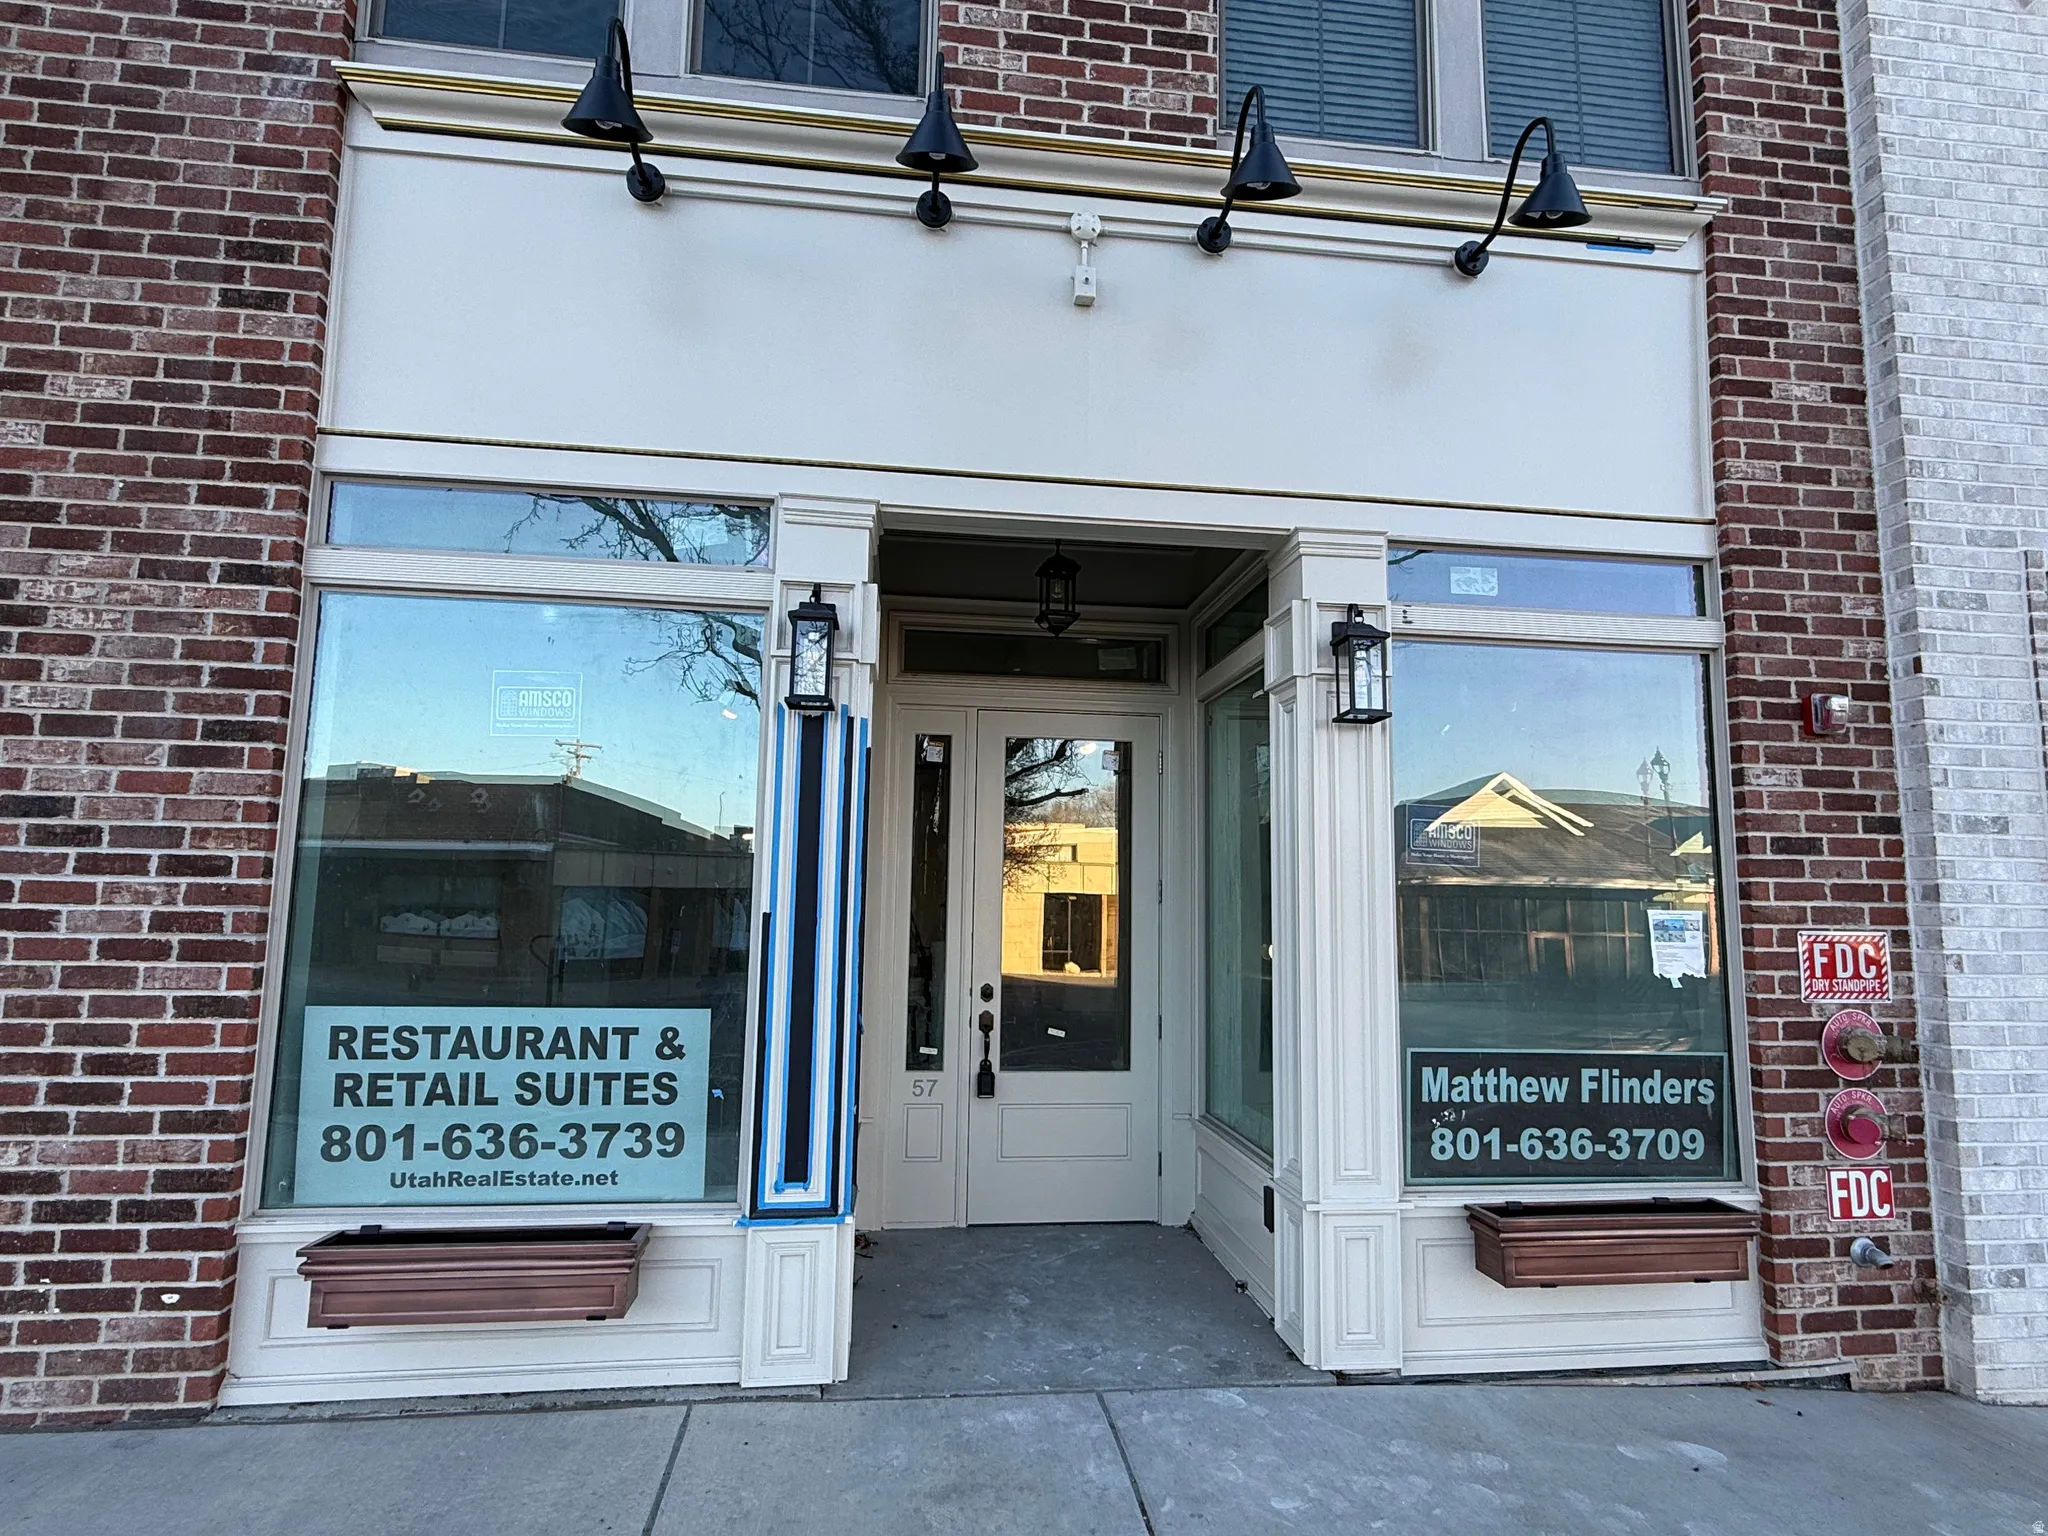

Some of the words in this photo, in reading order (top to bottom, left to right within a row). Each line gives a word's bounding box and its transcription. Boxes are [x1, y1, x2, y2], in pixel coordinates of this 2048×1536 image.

[519, 690, 572, 707] AMSCO
[518, 707, 572, 717] WINDOWS
[1428, 839, 1473, 850] WINDOWS
[1812, 943, 1877, 978] FDC
[1812, 979, 1829, 992] DRY
[1832, 979, 1881, 992] STANDPIPE
[1830, 1013, 1848, 1032] AUTO
[328, 1025, 640, 1061] RESTAURANT
[654, 1026, 686, 1060] &
[333, 1072, 499, 1108] RETAIL
[514, 1072, 679, 1107] SUITES
[912, 1079, 938, 1097] 57
[1421, 1066, 1570, 1103] Matthew
[1580, 1068, 1716, 1105] Flinders
[1830, 1094, 1847, 1115] AUTO
[320, 1121, 686, 1163] 801-636-3739
[1430, 1127, 1705, 1161] 801-636-3709
[389, 1169, 619, 1189] UtahRealEstate.net
[1831, 1170, 1890, 1219] FDC
